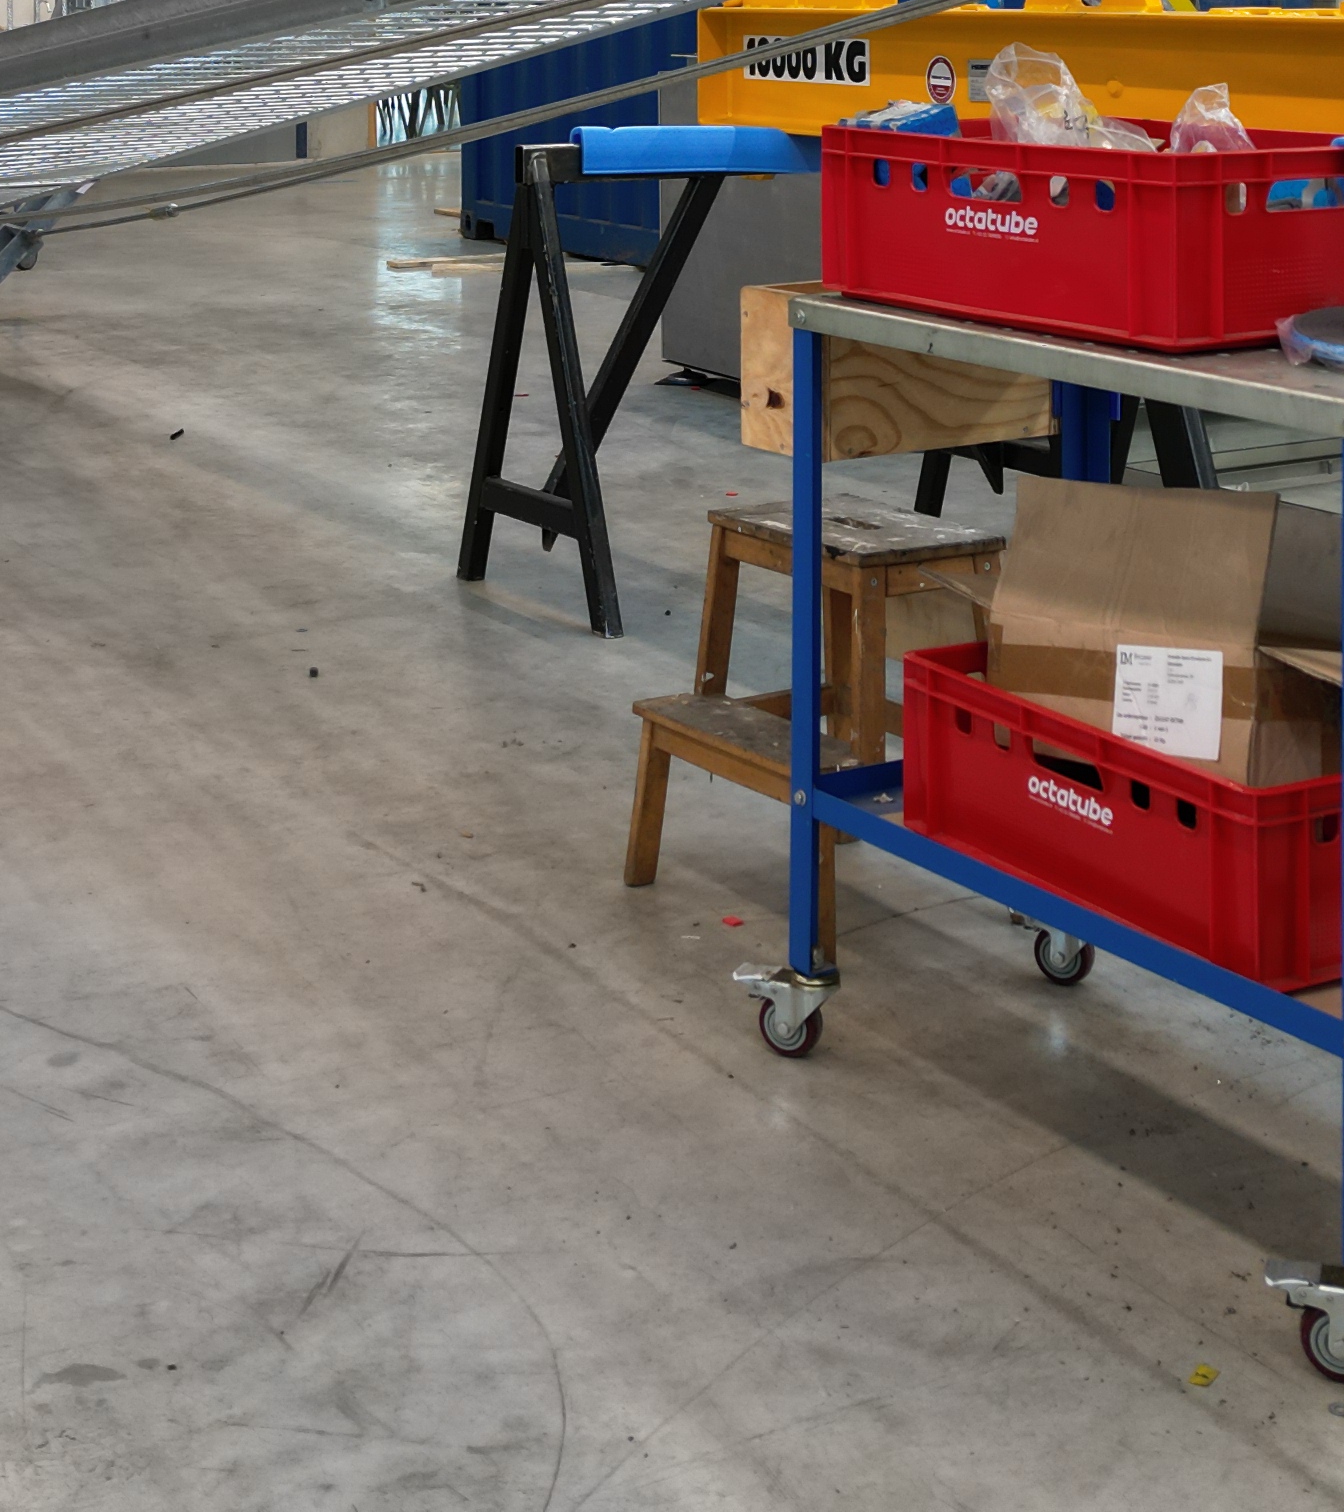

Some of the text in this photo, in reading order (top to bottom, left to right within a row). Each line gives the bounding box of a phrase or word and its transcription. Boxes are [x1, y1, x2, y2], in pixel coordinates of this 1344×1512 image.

[824, 41, 867, 83] KG
[945, 205, 1038, 236] octatube
[1028, 776, 1114, 827] octatube
